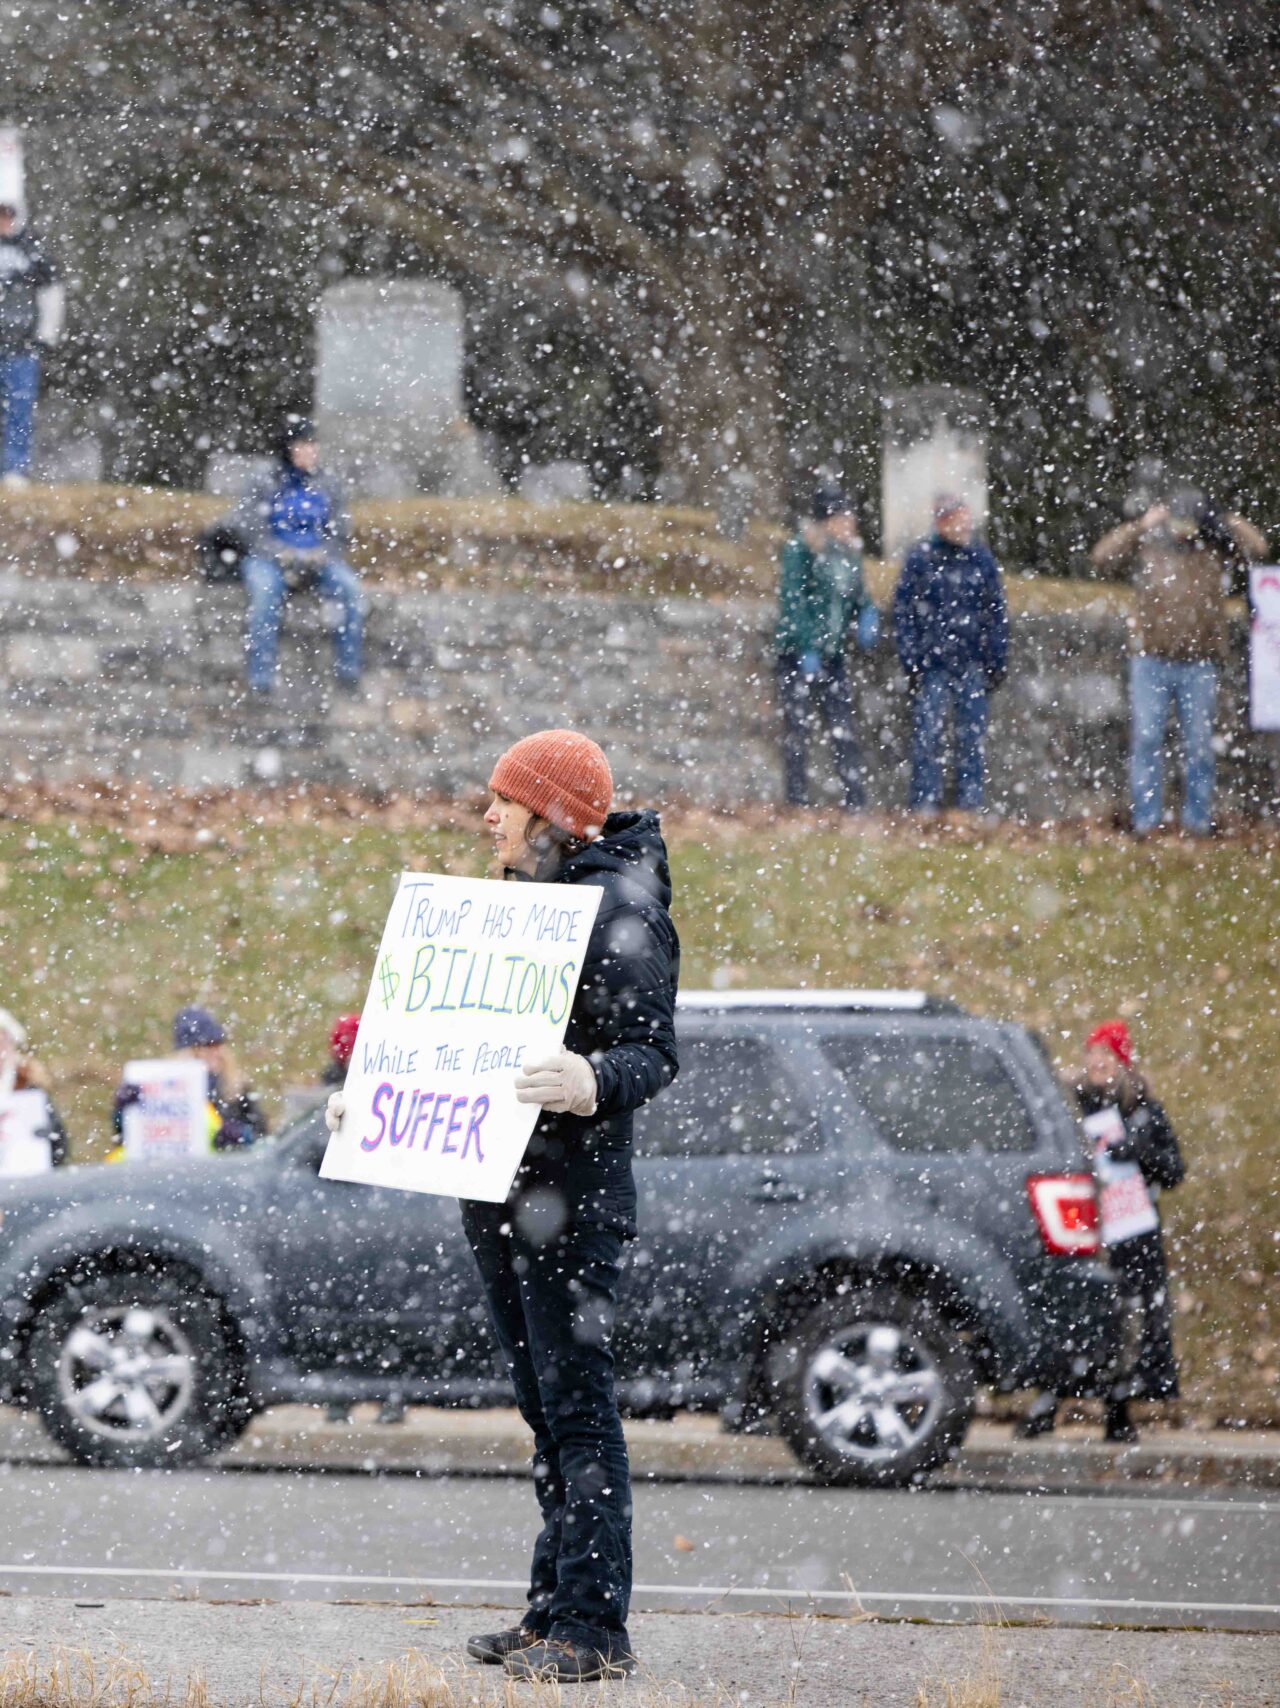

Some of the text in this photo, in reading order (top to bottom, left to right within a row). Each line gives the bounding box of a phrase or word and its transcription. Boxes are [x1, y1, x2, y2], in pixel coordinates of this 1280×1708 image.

[402, 883, 582, 942] TRUMP HAS MADE
[435, 1044, 464, 1071] THE
[472, 1042, 527, 1075] PEOPLE
[360, 1082, 490, 1163] SUFFER
